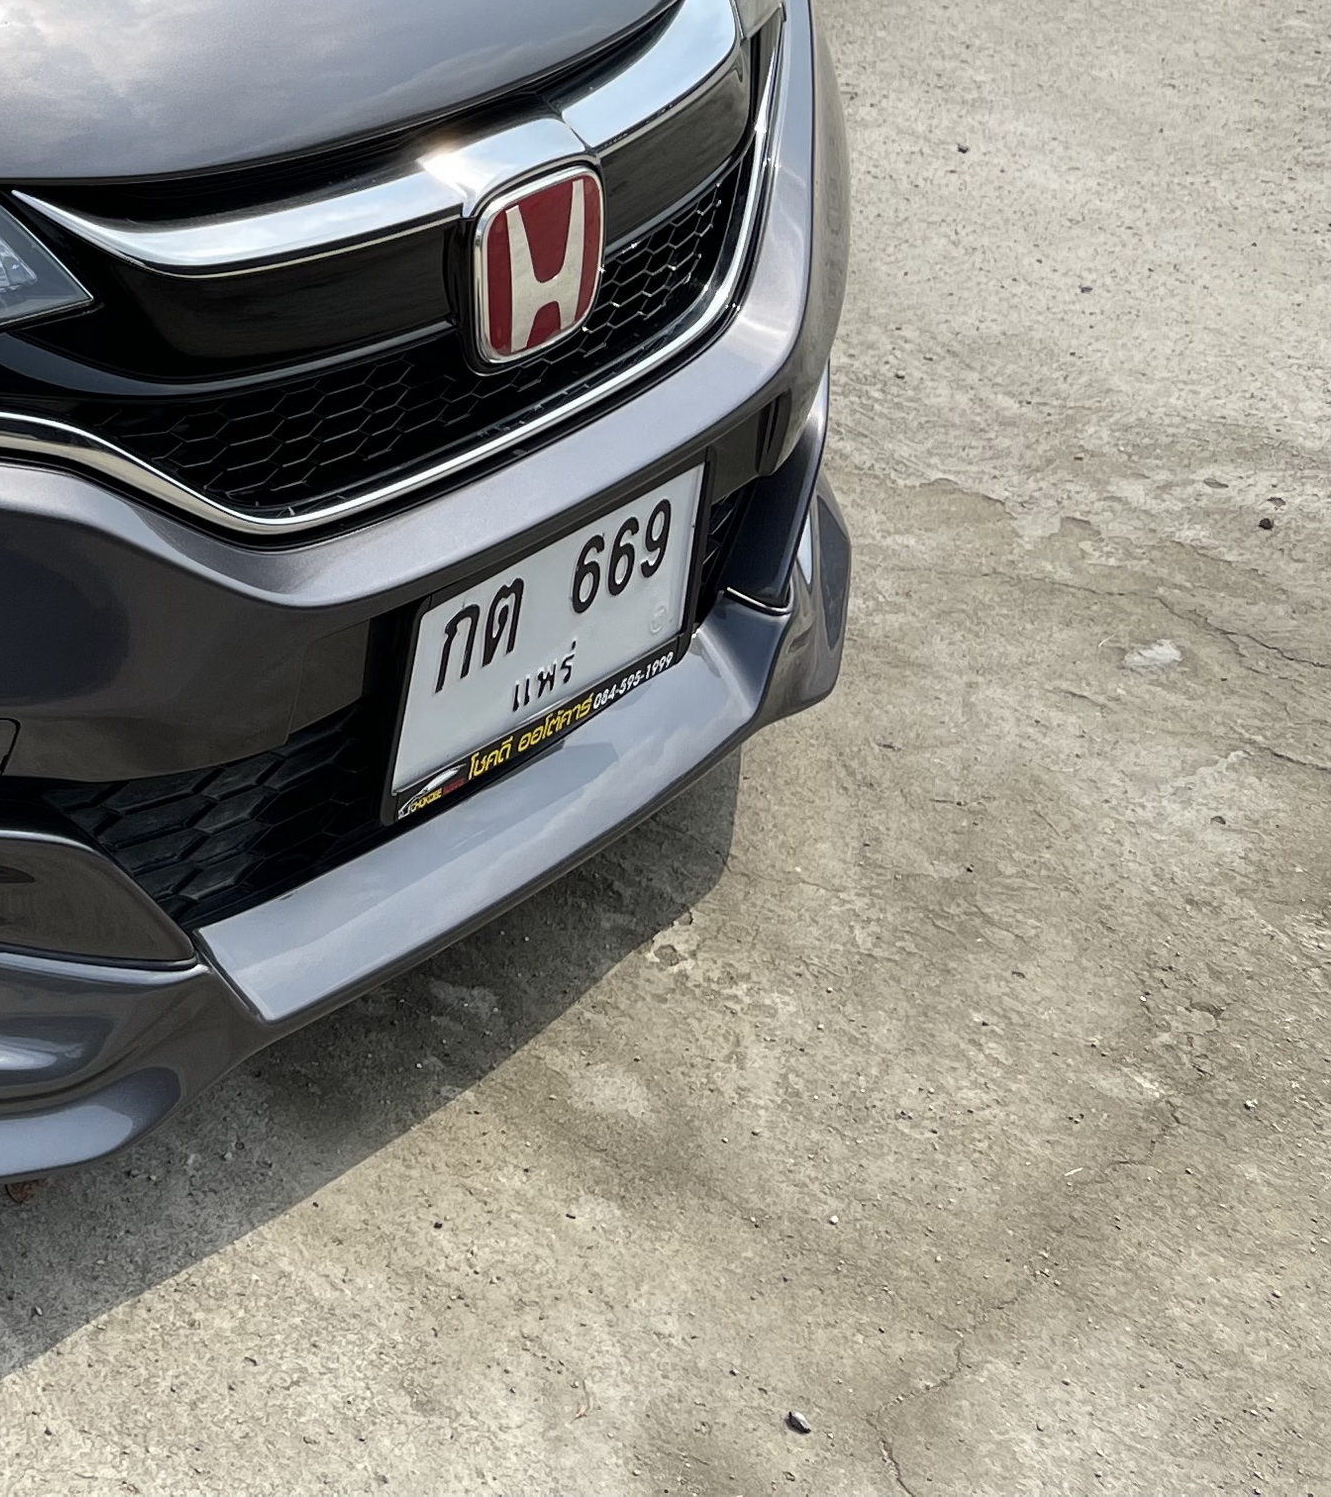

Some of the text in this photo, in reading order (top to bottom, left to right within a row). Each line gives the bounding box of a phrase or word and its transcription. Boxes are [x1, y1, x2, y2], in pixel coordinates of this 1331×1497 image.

[435, 498, 672, 694] กต 669
[468, 735, 514, 780] โชคดี
[592, 651, 674, 710] 084-595-1999
[512, 639, 577, 713] แพร่
